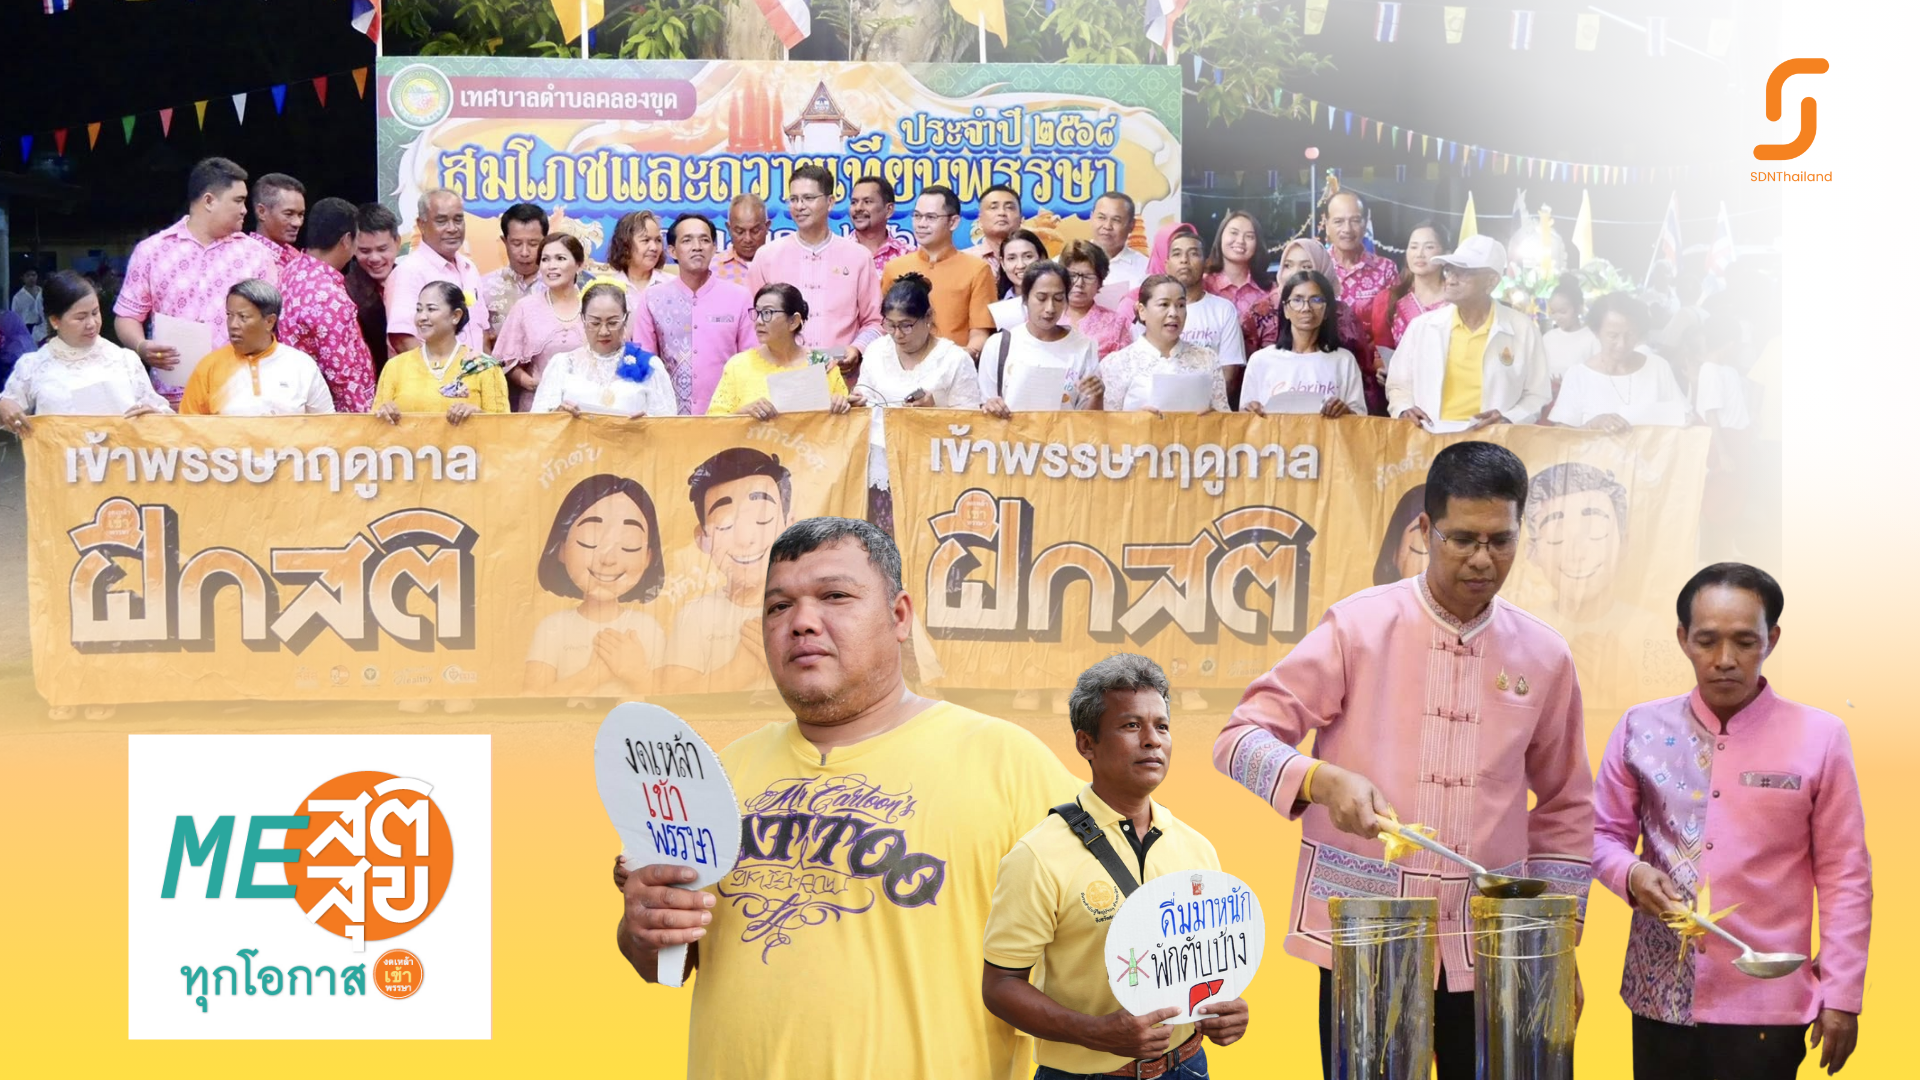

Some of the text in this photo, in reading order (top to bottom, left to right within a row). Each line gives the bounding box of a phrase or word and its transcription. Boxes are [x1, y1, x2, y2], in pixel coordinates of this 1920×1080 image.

[460, 82, 678, 117] เทศบาลตำบลคลองขุด
[901, 107, 1118, 147] ประจำปี ๒๕๖๘
[65, 431, 478, 499] เข้าพรรษาฤดูกาล
[930, 424, 1319, 495] เข้าพรรษาฤดูกาล
[68, 497, 480, 656] ฝึกสติ
[926, 488, 1317, 647] ฝึกสติ
[625, 731, 704, 780] งดเหล้า
[642, 778, 688, 821] เข้า
[646, 820, 718, 868] พรรษา
[1158, 886, 1252, 938] ดื่มมาหนัก
[1151, 927, 1248, 989] พักตับบ้าง
